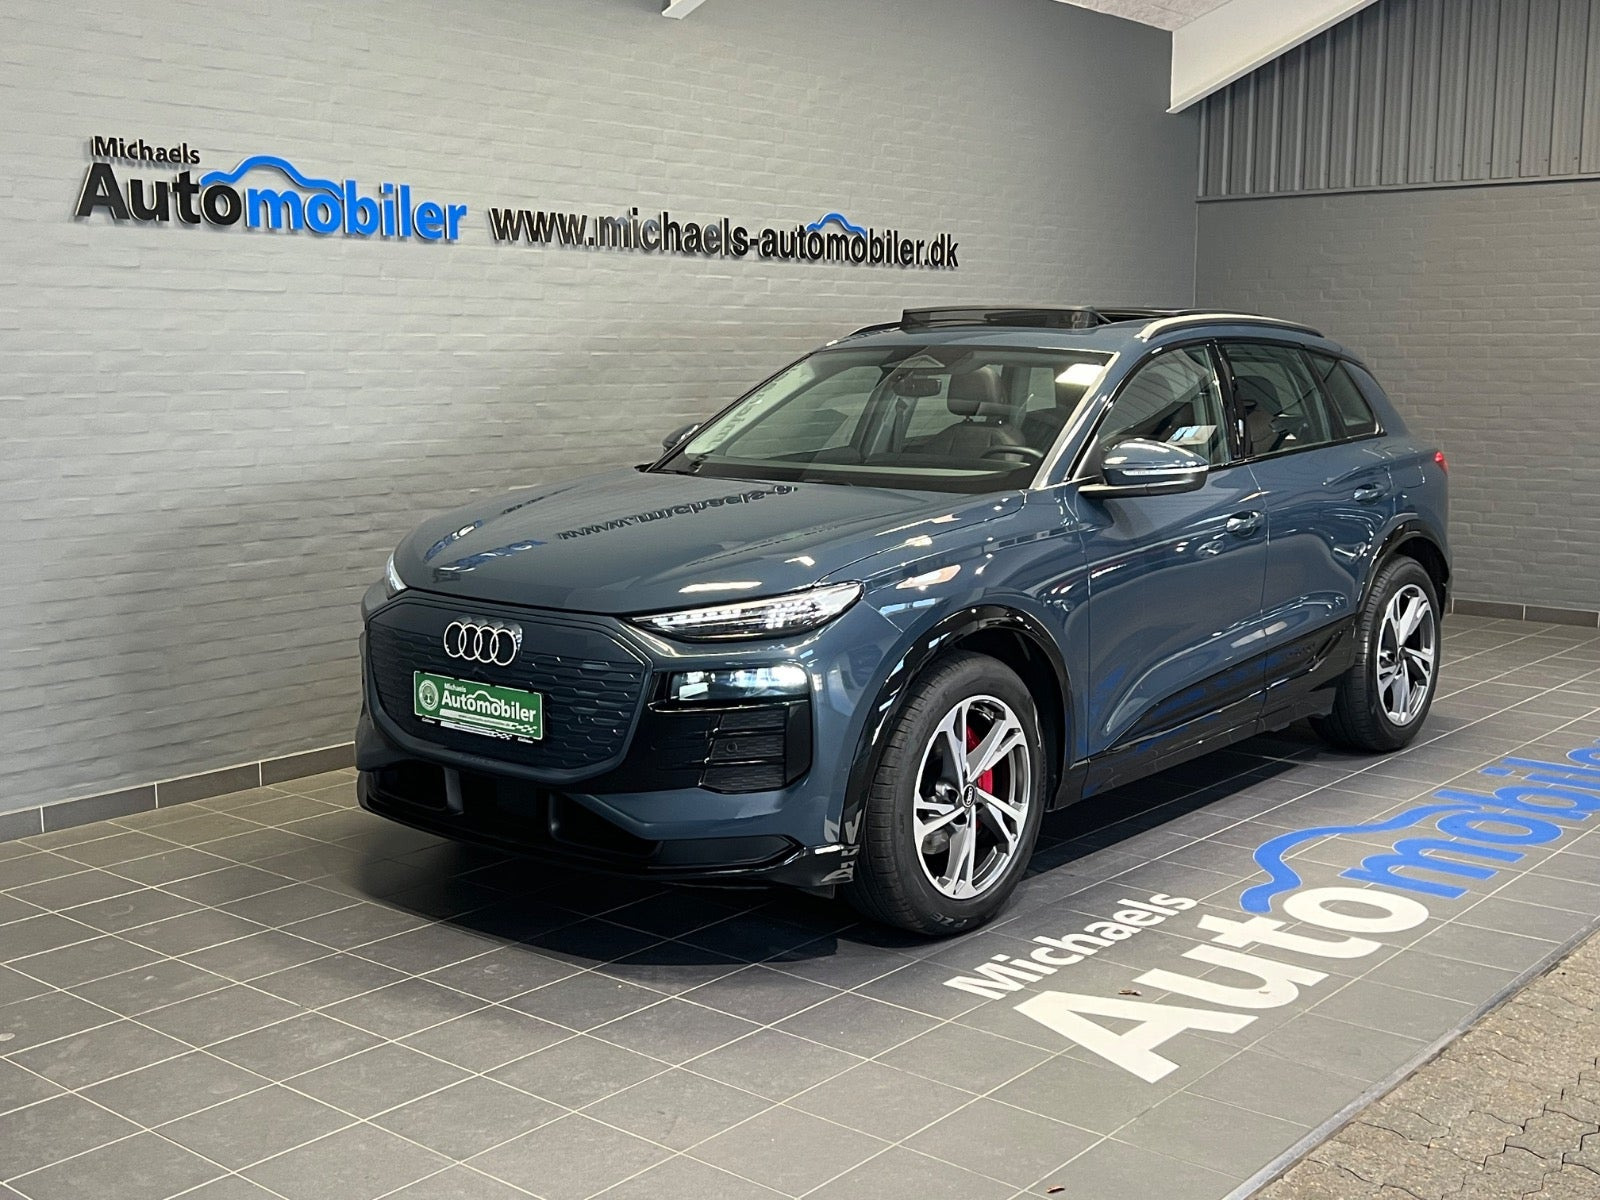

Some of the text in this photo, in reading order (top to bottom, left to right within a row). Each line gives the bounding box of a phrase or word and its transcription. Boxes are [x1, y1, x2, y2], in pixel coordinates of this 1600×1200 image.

[92, 135, 200, 164] Michaels
[75, 161, 467, 241] Automobiler
[488, 207, 959, 267] www.michaels-automobiler.dk
[442, 690, 536, 722] Automobiler
[943, 893, 1198, 1000] Michaels
